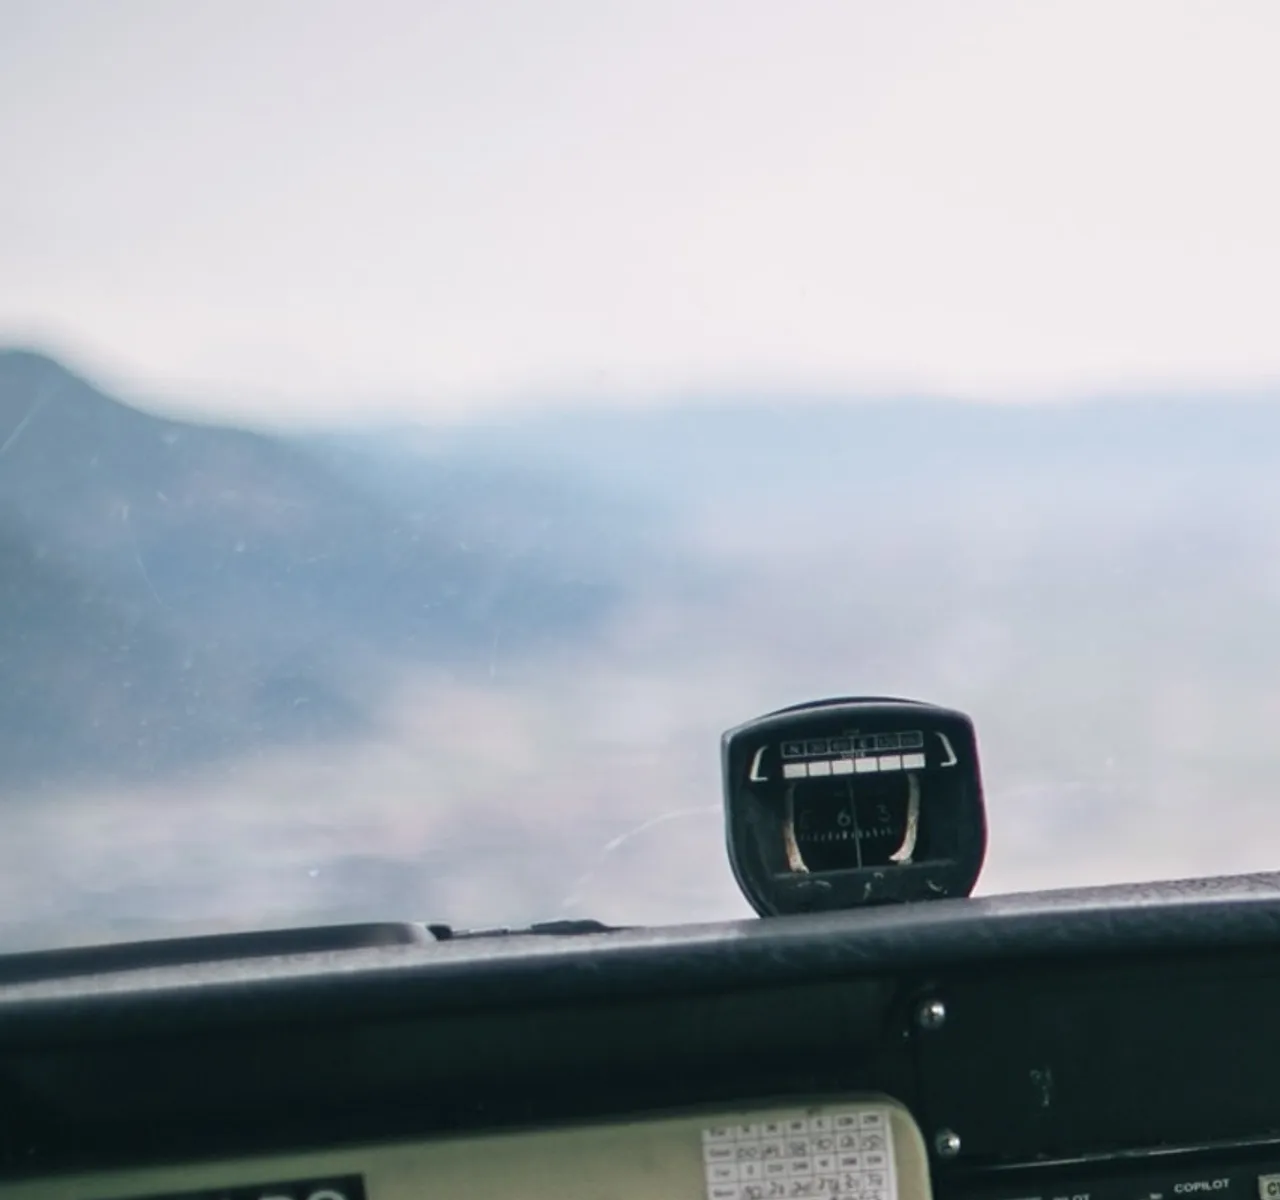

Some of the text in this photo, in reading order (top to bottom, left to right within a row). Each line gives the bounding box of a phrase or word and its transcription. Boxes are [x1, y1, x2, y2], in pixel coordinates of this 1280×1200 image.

[837, 806, 851, 827] 6
[876, 804, 892, 822] 3
[1174, 1178, 1231, 1194] COPILOT
